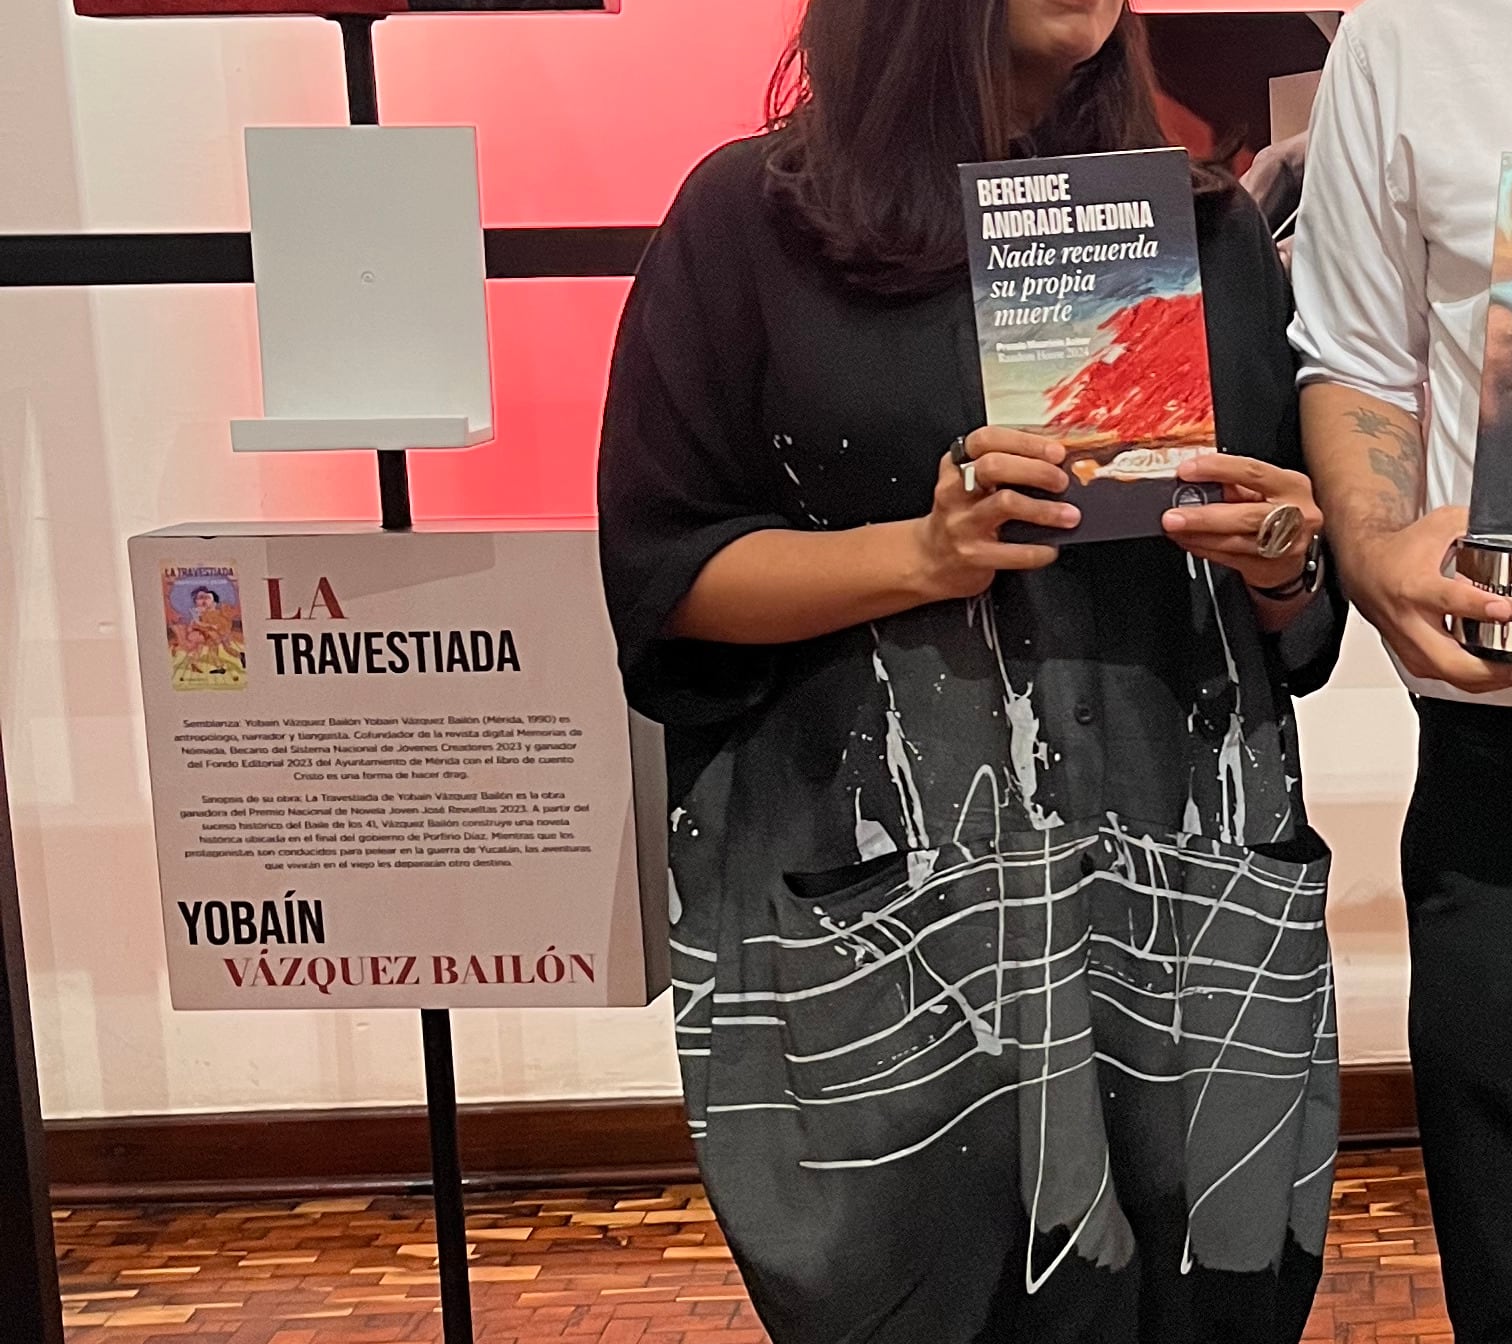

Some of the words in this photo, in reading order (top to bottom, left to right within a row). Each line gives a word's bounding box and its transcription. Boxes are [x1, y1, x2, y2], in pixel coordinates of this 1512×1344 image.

[977, 173, 1070, 206] BERENICE
[983, 206, 1073, 239] ANDRADE
[1076, 201, 1154, 235] MEDINA
[987, 244, 1056, 271] Nadie
[1061, 236, 1158, 264] recuerda
[990, 279, 1015, 299] su
[1022, 271, 1095, 302] propia
[995, 302, 1073, 326] muerte
[263, 576, 348, 621] LA
[267, 630, 521, 675] TRAVESTIADA
[187, 760, 202, 768] del
[206, 760, 238, 768] Fondo
[242, 759, 284, 768] Editorial
[287, 759, 312, 767] 2023
[316, 759, 331, 767] del
[335, 758, 406, 768] Ayuntamiento
[410, 757, 422, 765] de
[485, 756, 493, 764] el
[497, 756, 519, 764] libro
[523, 756, 535, 764] de
[293, 772, 324, 780] Cristo
[202, 795, 243, 804] Sinopsis
[306, 794, 317, 802] La
[321, 794, 378, 802] Travestiada
[381, 793, 394, 801] de
[435, 792, 477, 801] Vázquez
[178, 890, 326, 946] YOBAÍN
[224, 949, 420, 994] VÁZQUEZ
[432, 946, 596, 985] BAILÓN
